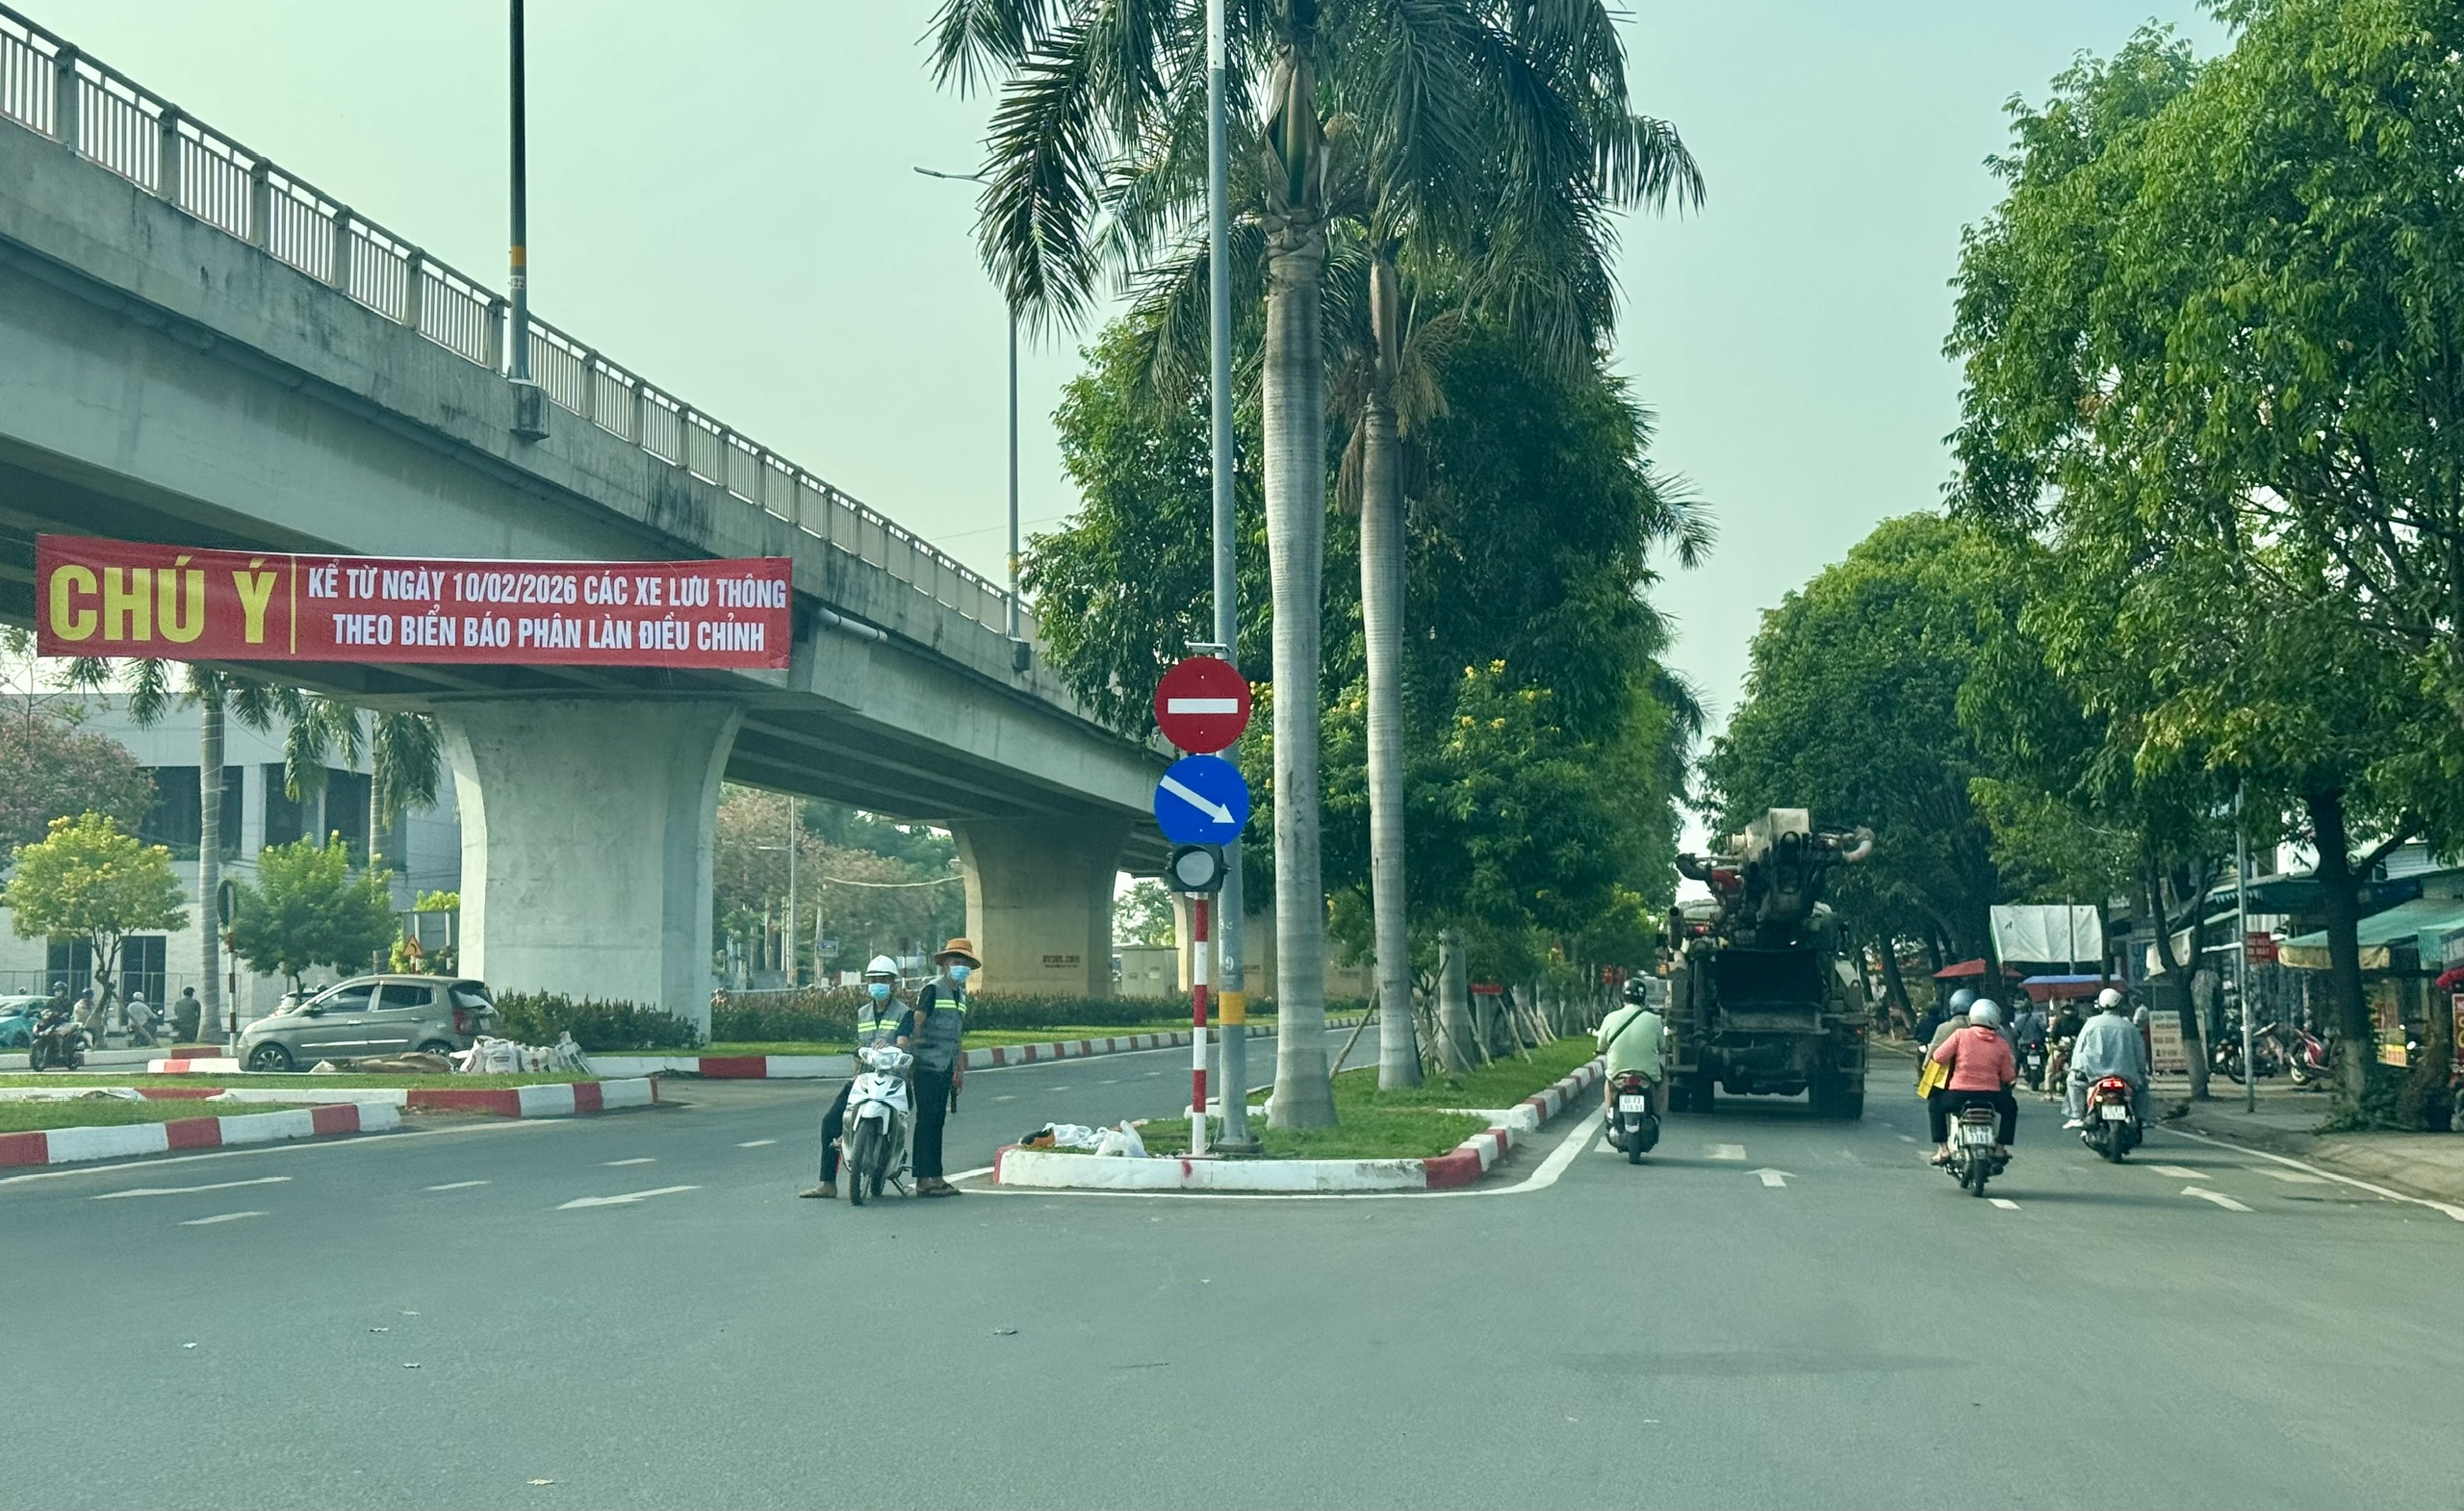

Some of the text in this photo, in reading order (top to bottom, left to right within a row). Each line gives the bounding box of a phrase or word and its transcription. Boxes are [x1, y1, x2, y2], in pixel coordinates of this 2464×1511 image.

[49, 555, 277, 644] CHÚ Ý
[308, 559, 786, 608] KỂ TỪ NGÀY 10/02/2026 CÁC XE LƯU THÔNG
[333, 604, 765, 652] THEO BIỂN BÁO PHÂN LÀN ĐIỀU CHỈNH
